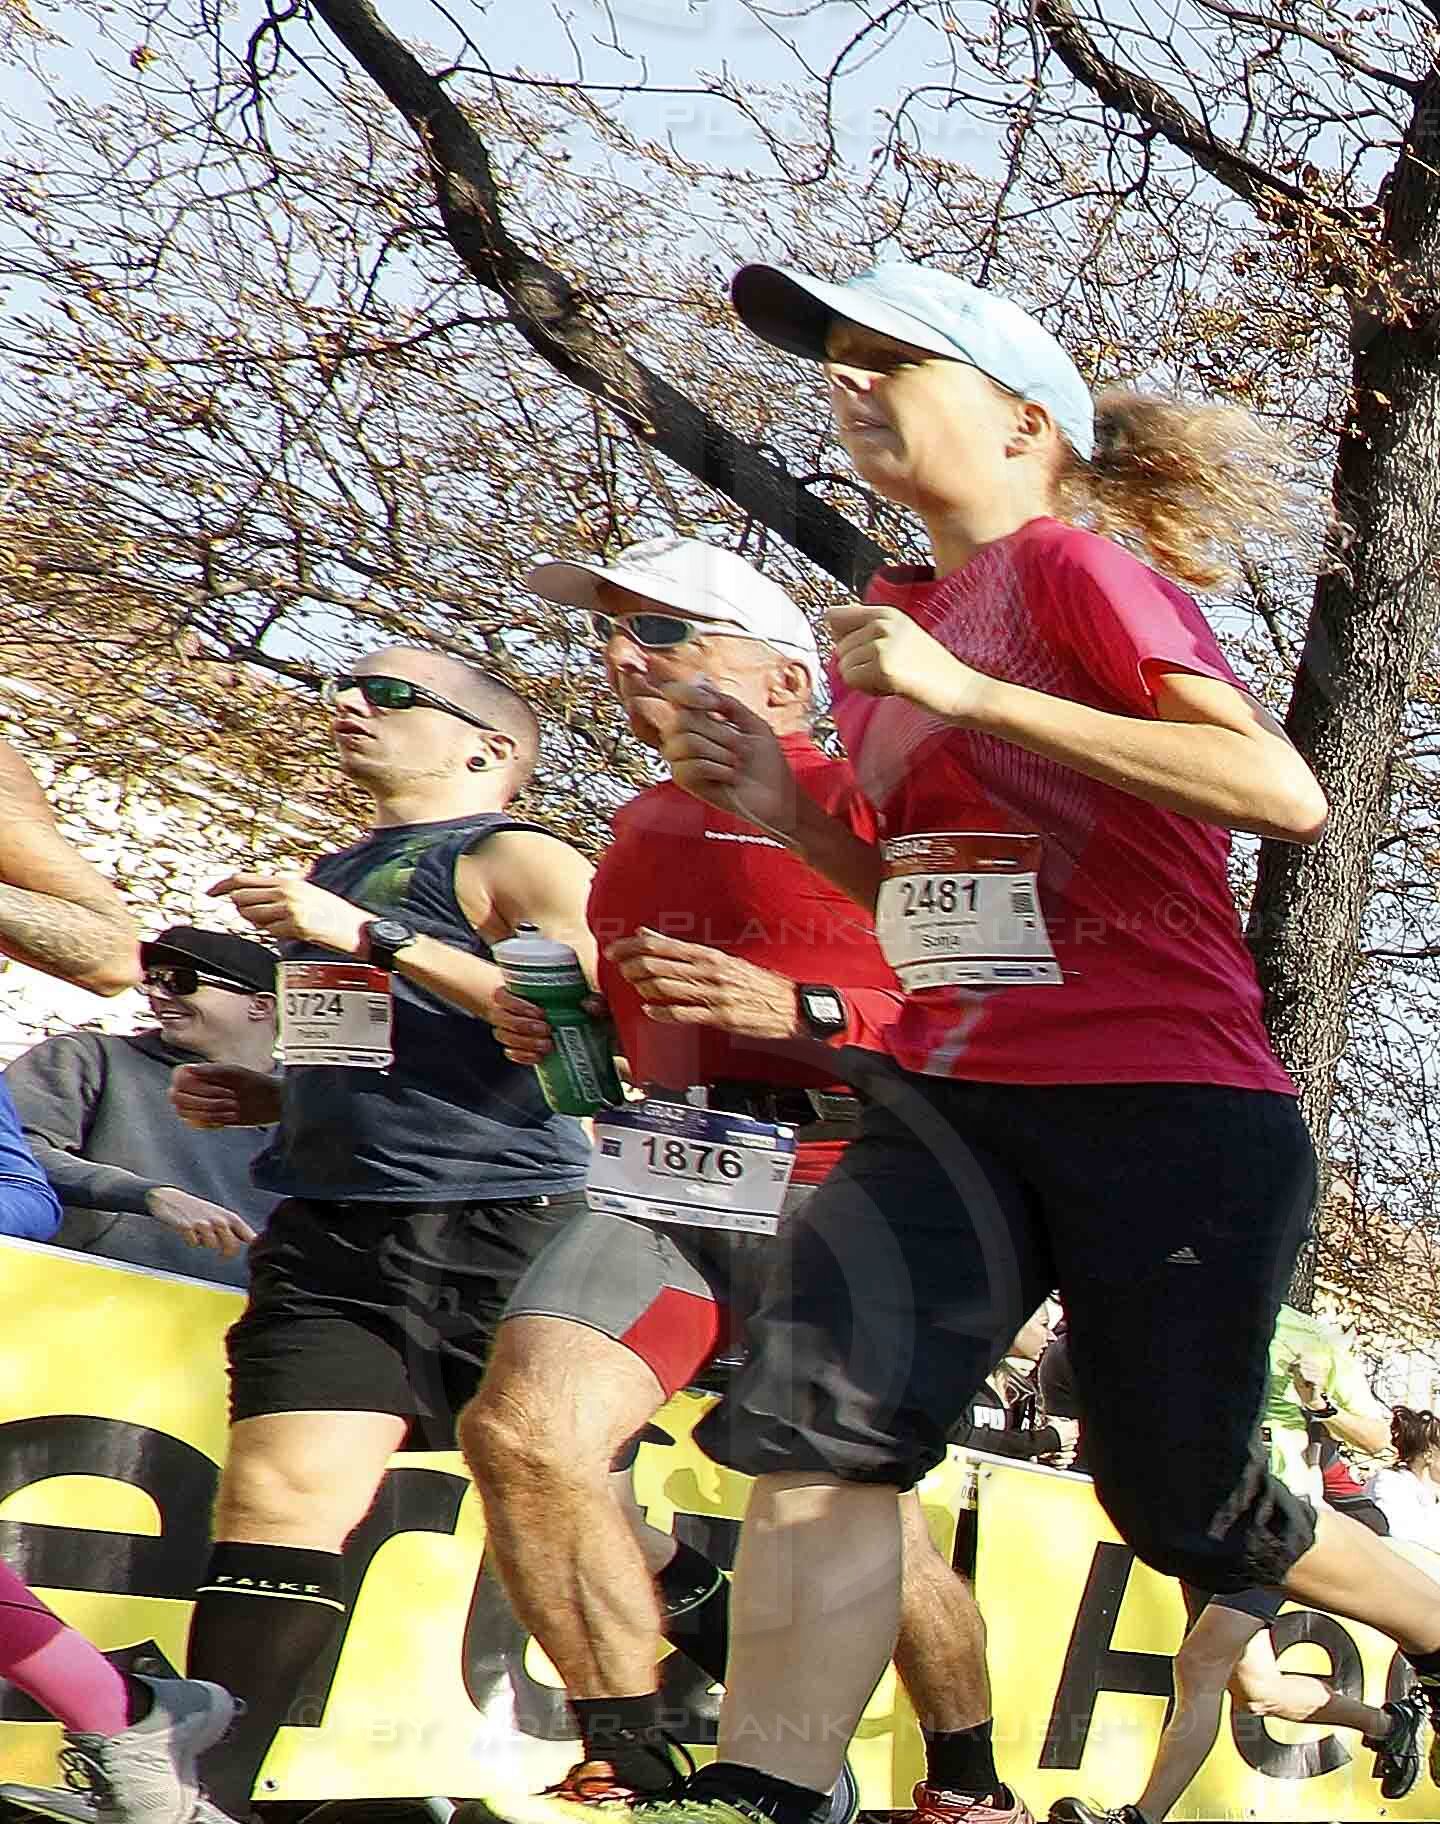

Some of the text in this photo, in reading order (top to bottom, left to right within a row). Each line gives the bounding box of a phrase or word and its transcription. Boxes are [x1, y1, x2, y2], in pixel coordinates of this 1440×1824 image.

[900, 879, 979, 917] 2481
[642, 1135, 743, 1179] 1876
[216, 1576, 324, 1595] FALKE
